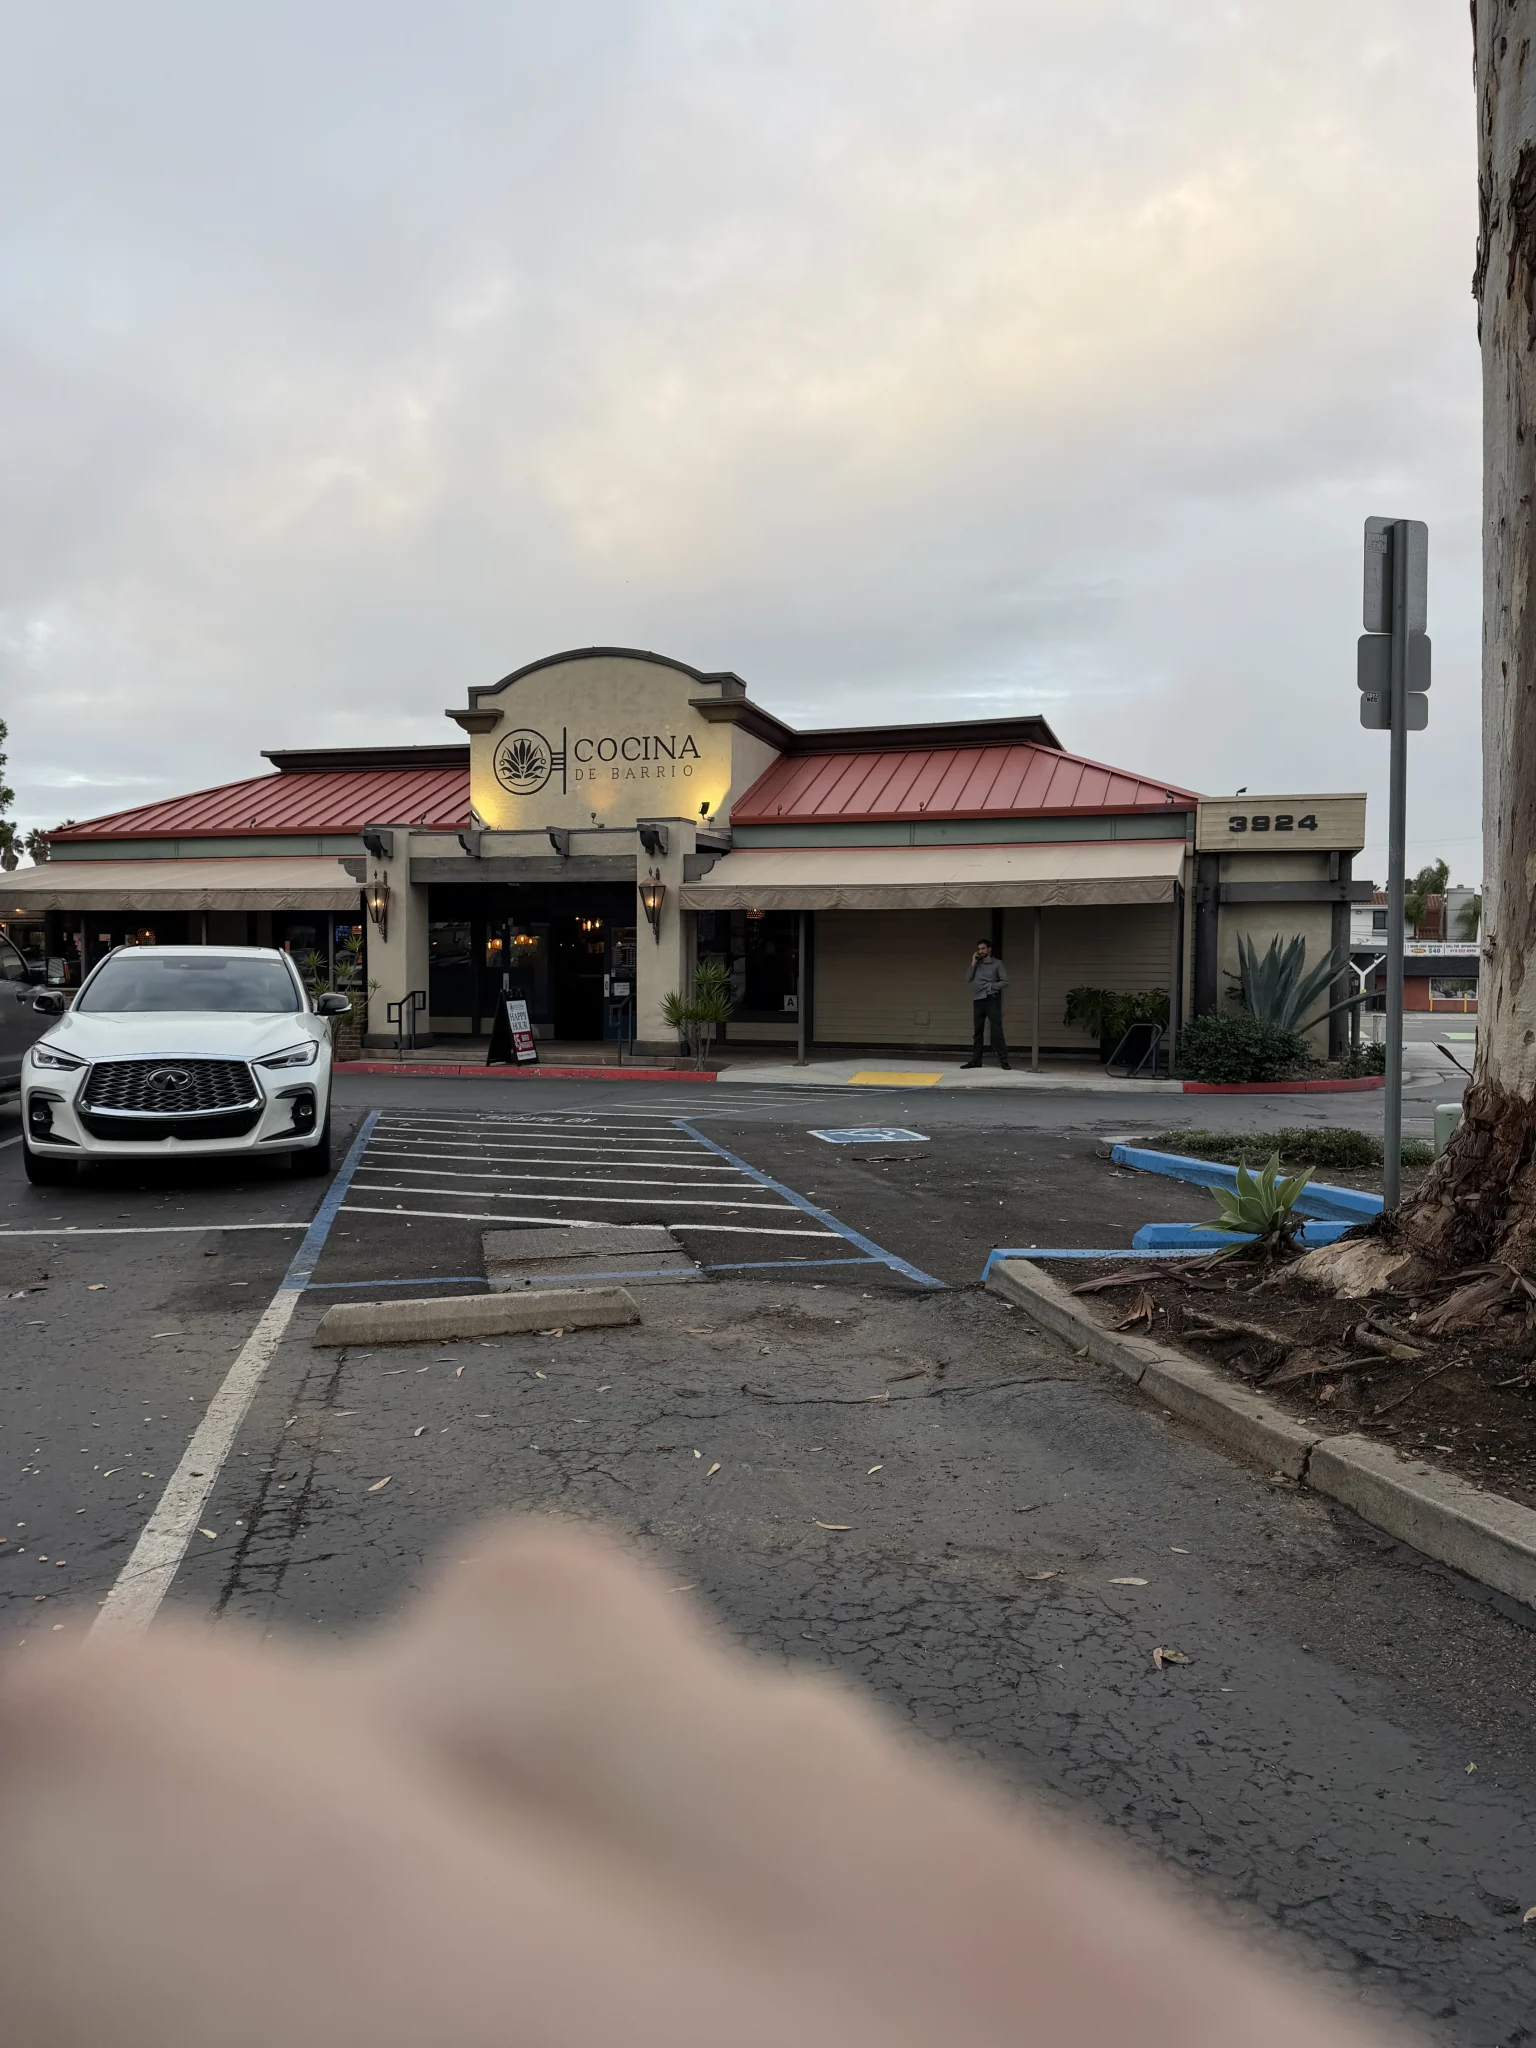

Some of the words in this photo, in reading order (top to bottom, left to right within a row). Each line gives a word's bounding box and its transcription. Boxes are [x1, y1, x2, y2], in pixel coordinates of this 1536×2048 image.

[574, 734, 702, 763] COCINA
[574, 768, 597, 781] DE
[611, 764, 694, 780] BARRIO
[1228, 814, 1318, 833] 3924
[787, 997, 795, 1007] A
[509, 1011, 527, 1024] HAPPY
[511, 1021, 529, 1031] HOUR
